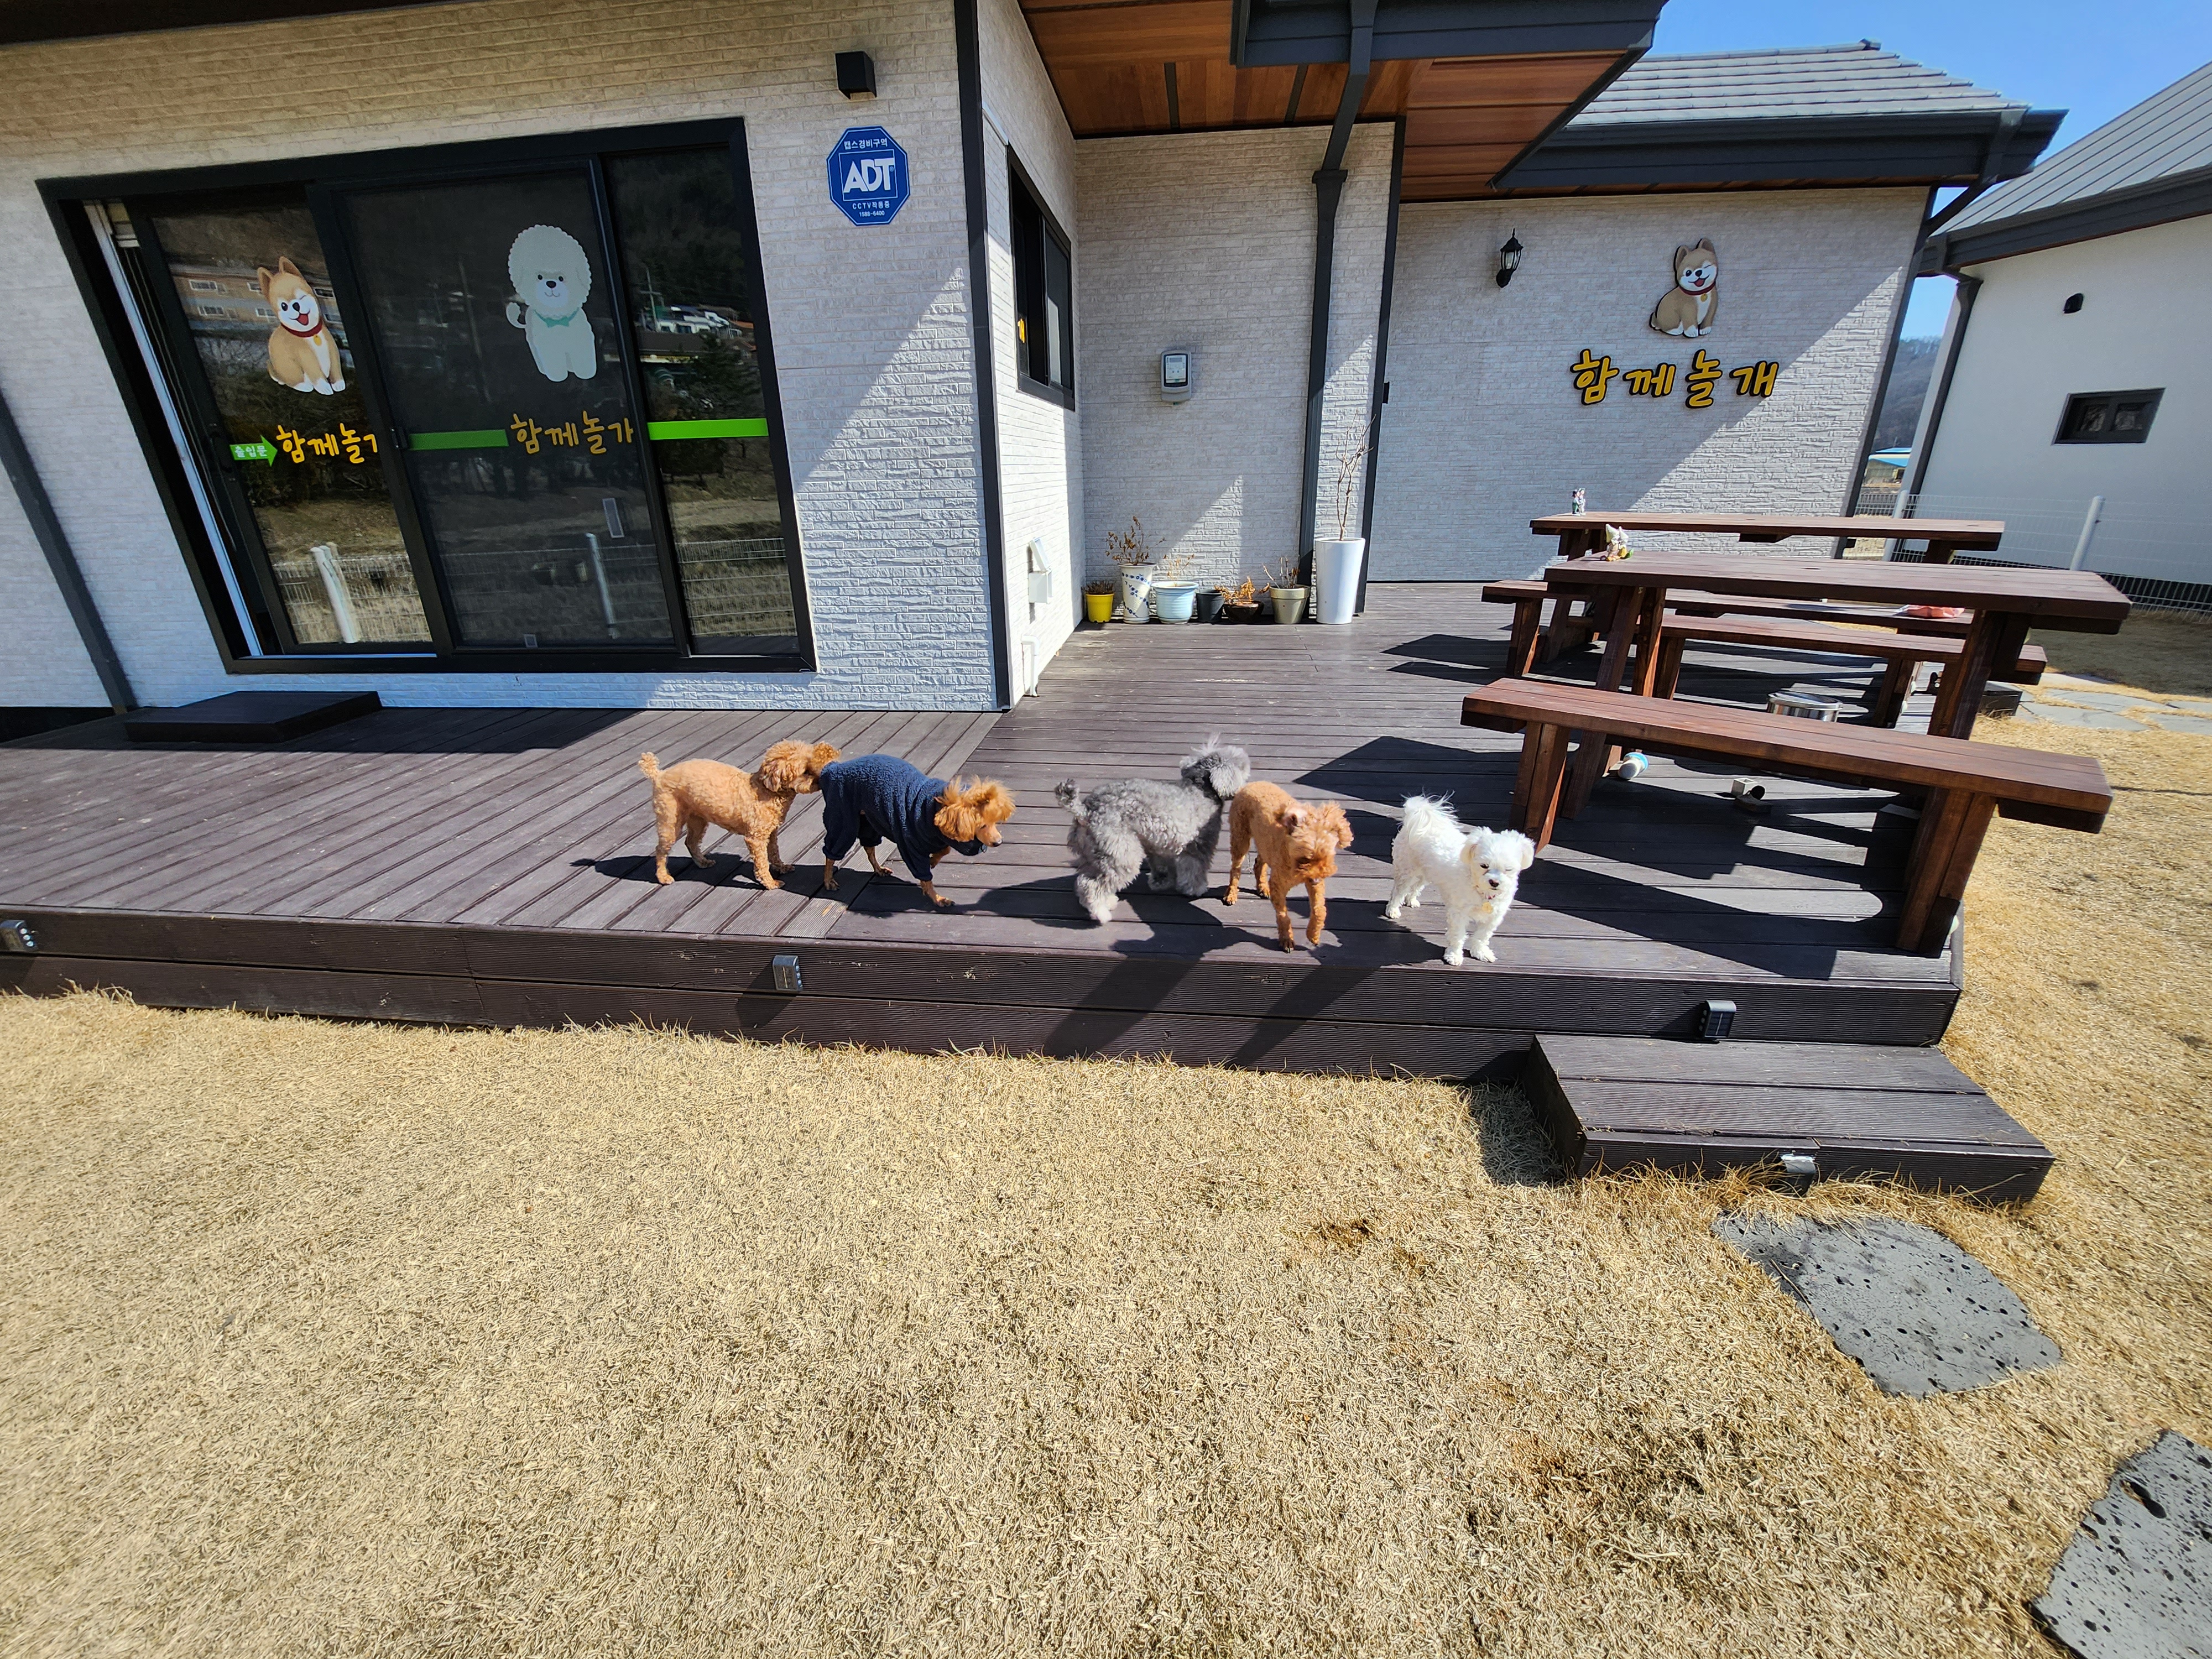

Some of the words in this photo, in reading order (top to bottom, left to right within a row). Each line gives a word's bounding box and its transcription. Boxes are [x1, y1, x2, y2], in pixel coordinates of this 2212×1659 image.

[843, 138, 888, 150] 캡스경비구역
[843, 158, 895, 193] ADT
[1571, 349, 1779, 408] 함께놀개
[234, 445, 268, 458] 출입문
